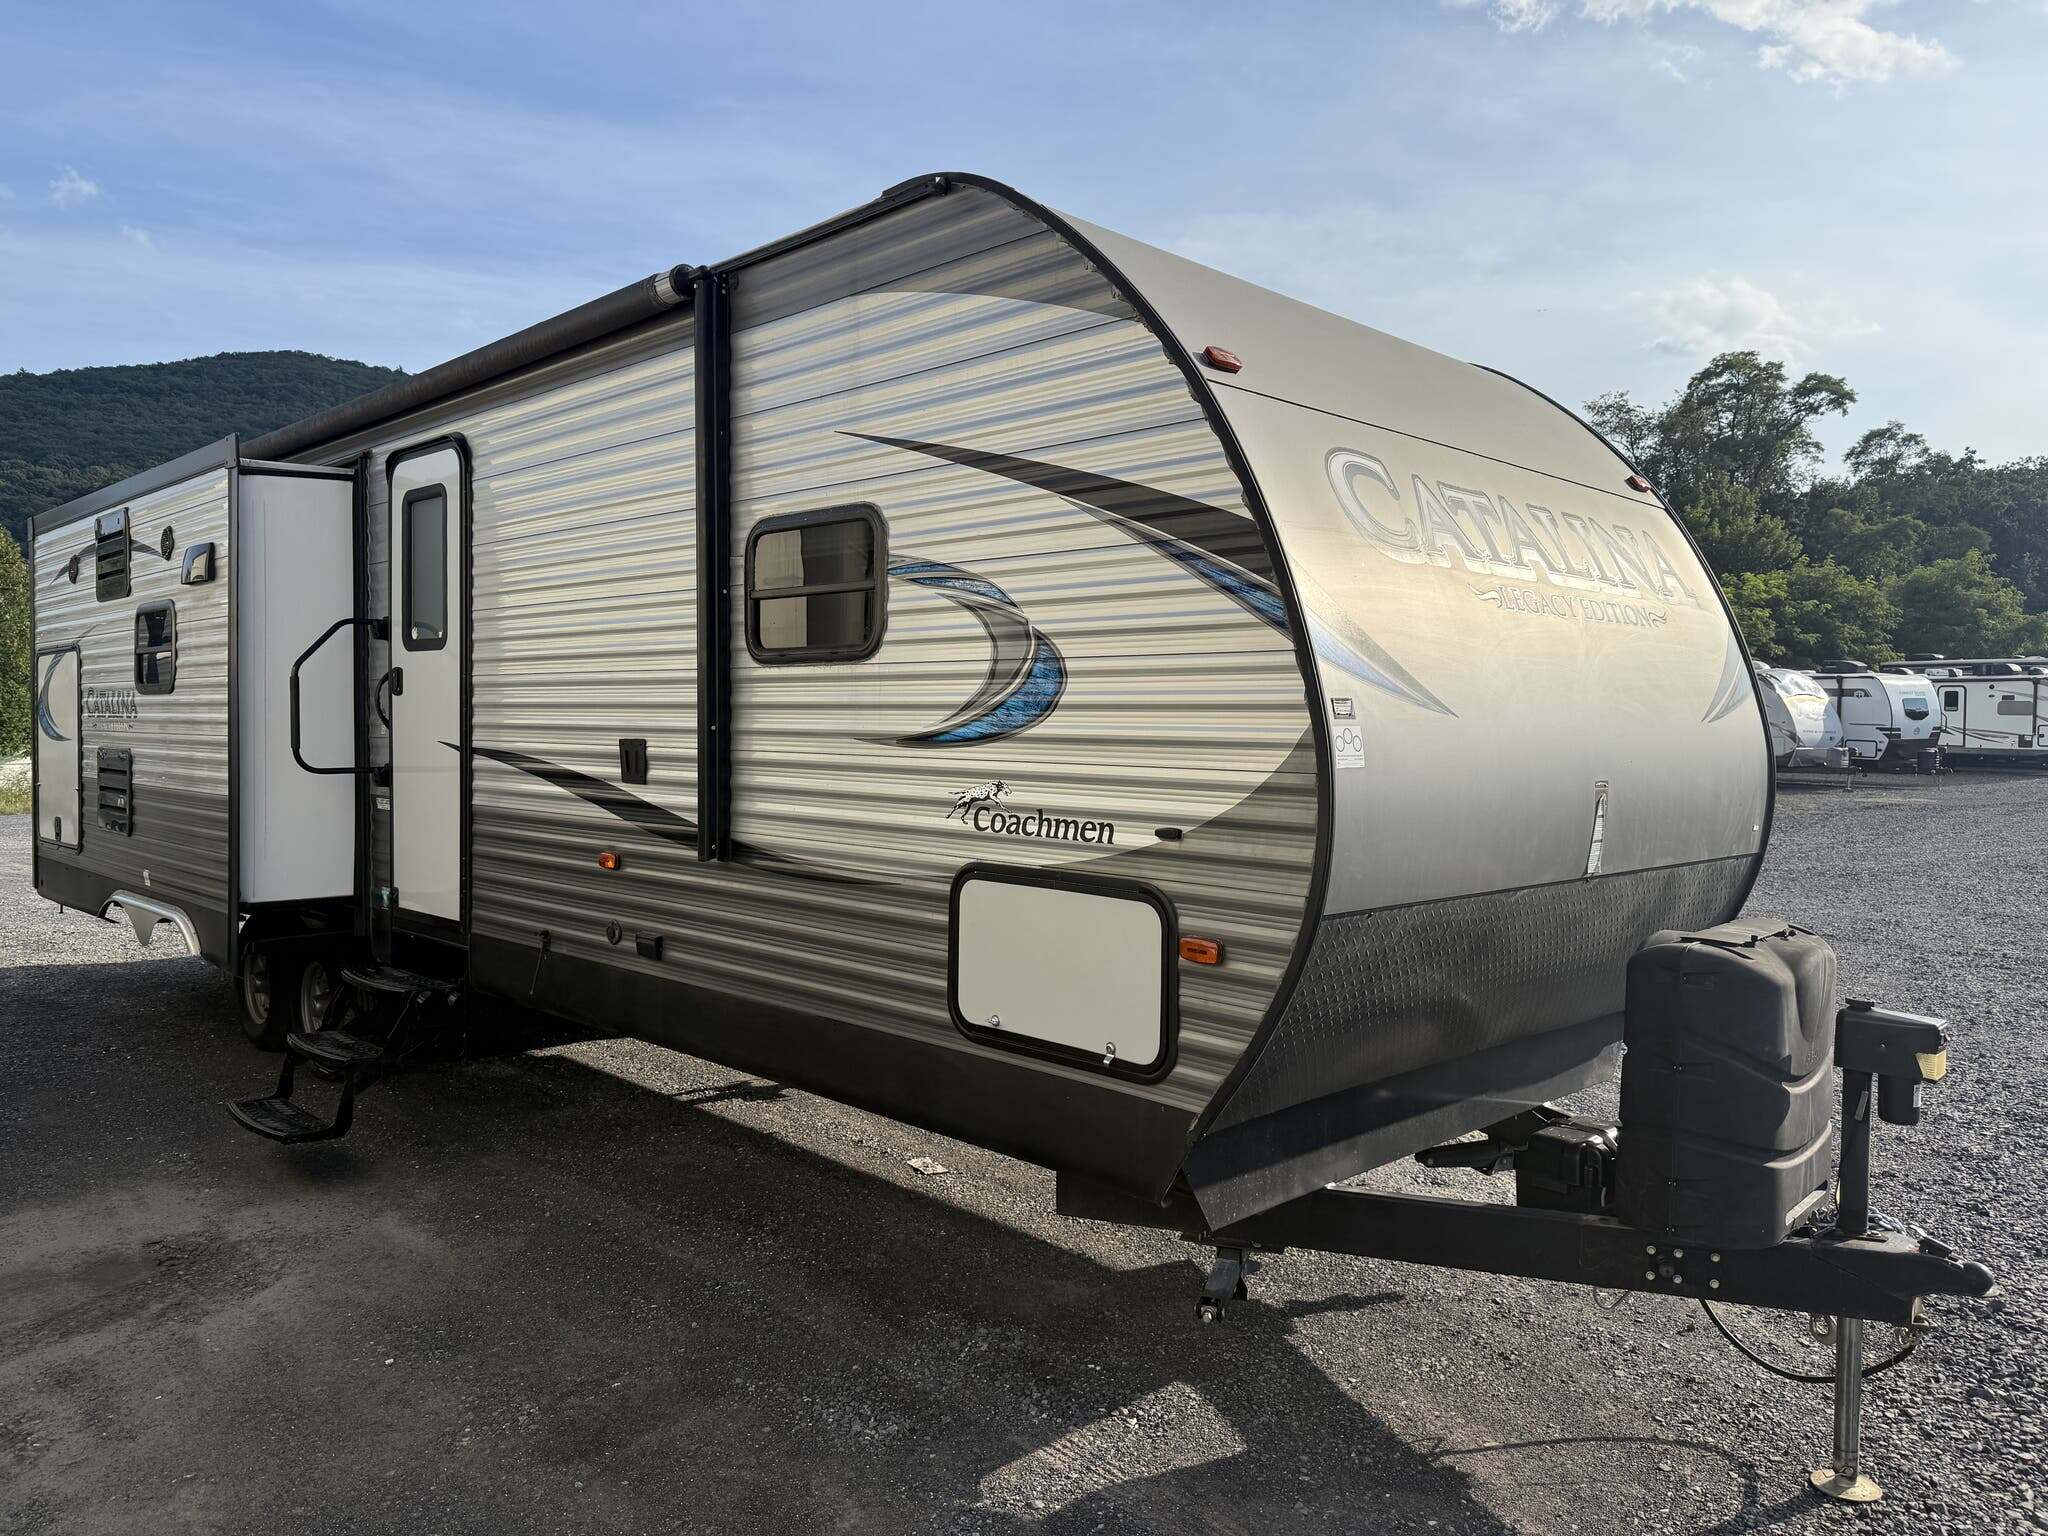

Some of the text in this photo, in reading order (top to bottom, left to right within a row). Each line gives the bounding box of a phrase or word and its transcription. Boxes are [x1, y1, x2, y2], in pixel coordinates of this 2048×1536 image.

[1324, 446, 1697, 599] CATALINA
[1496, 585, 1651, 628] LEGACY EDITION
[85, 688, 138, 717] CATALINA
[973, 806, 1115, 845] Coachmen
